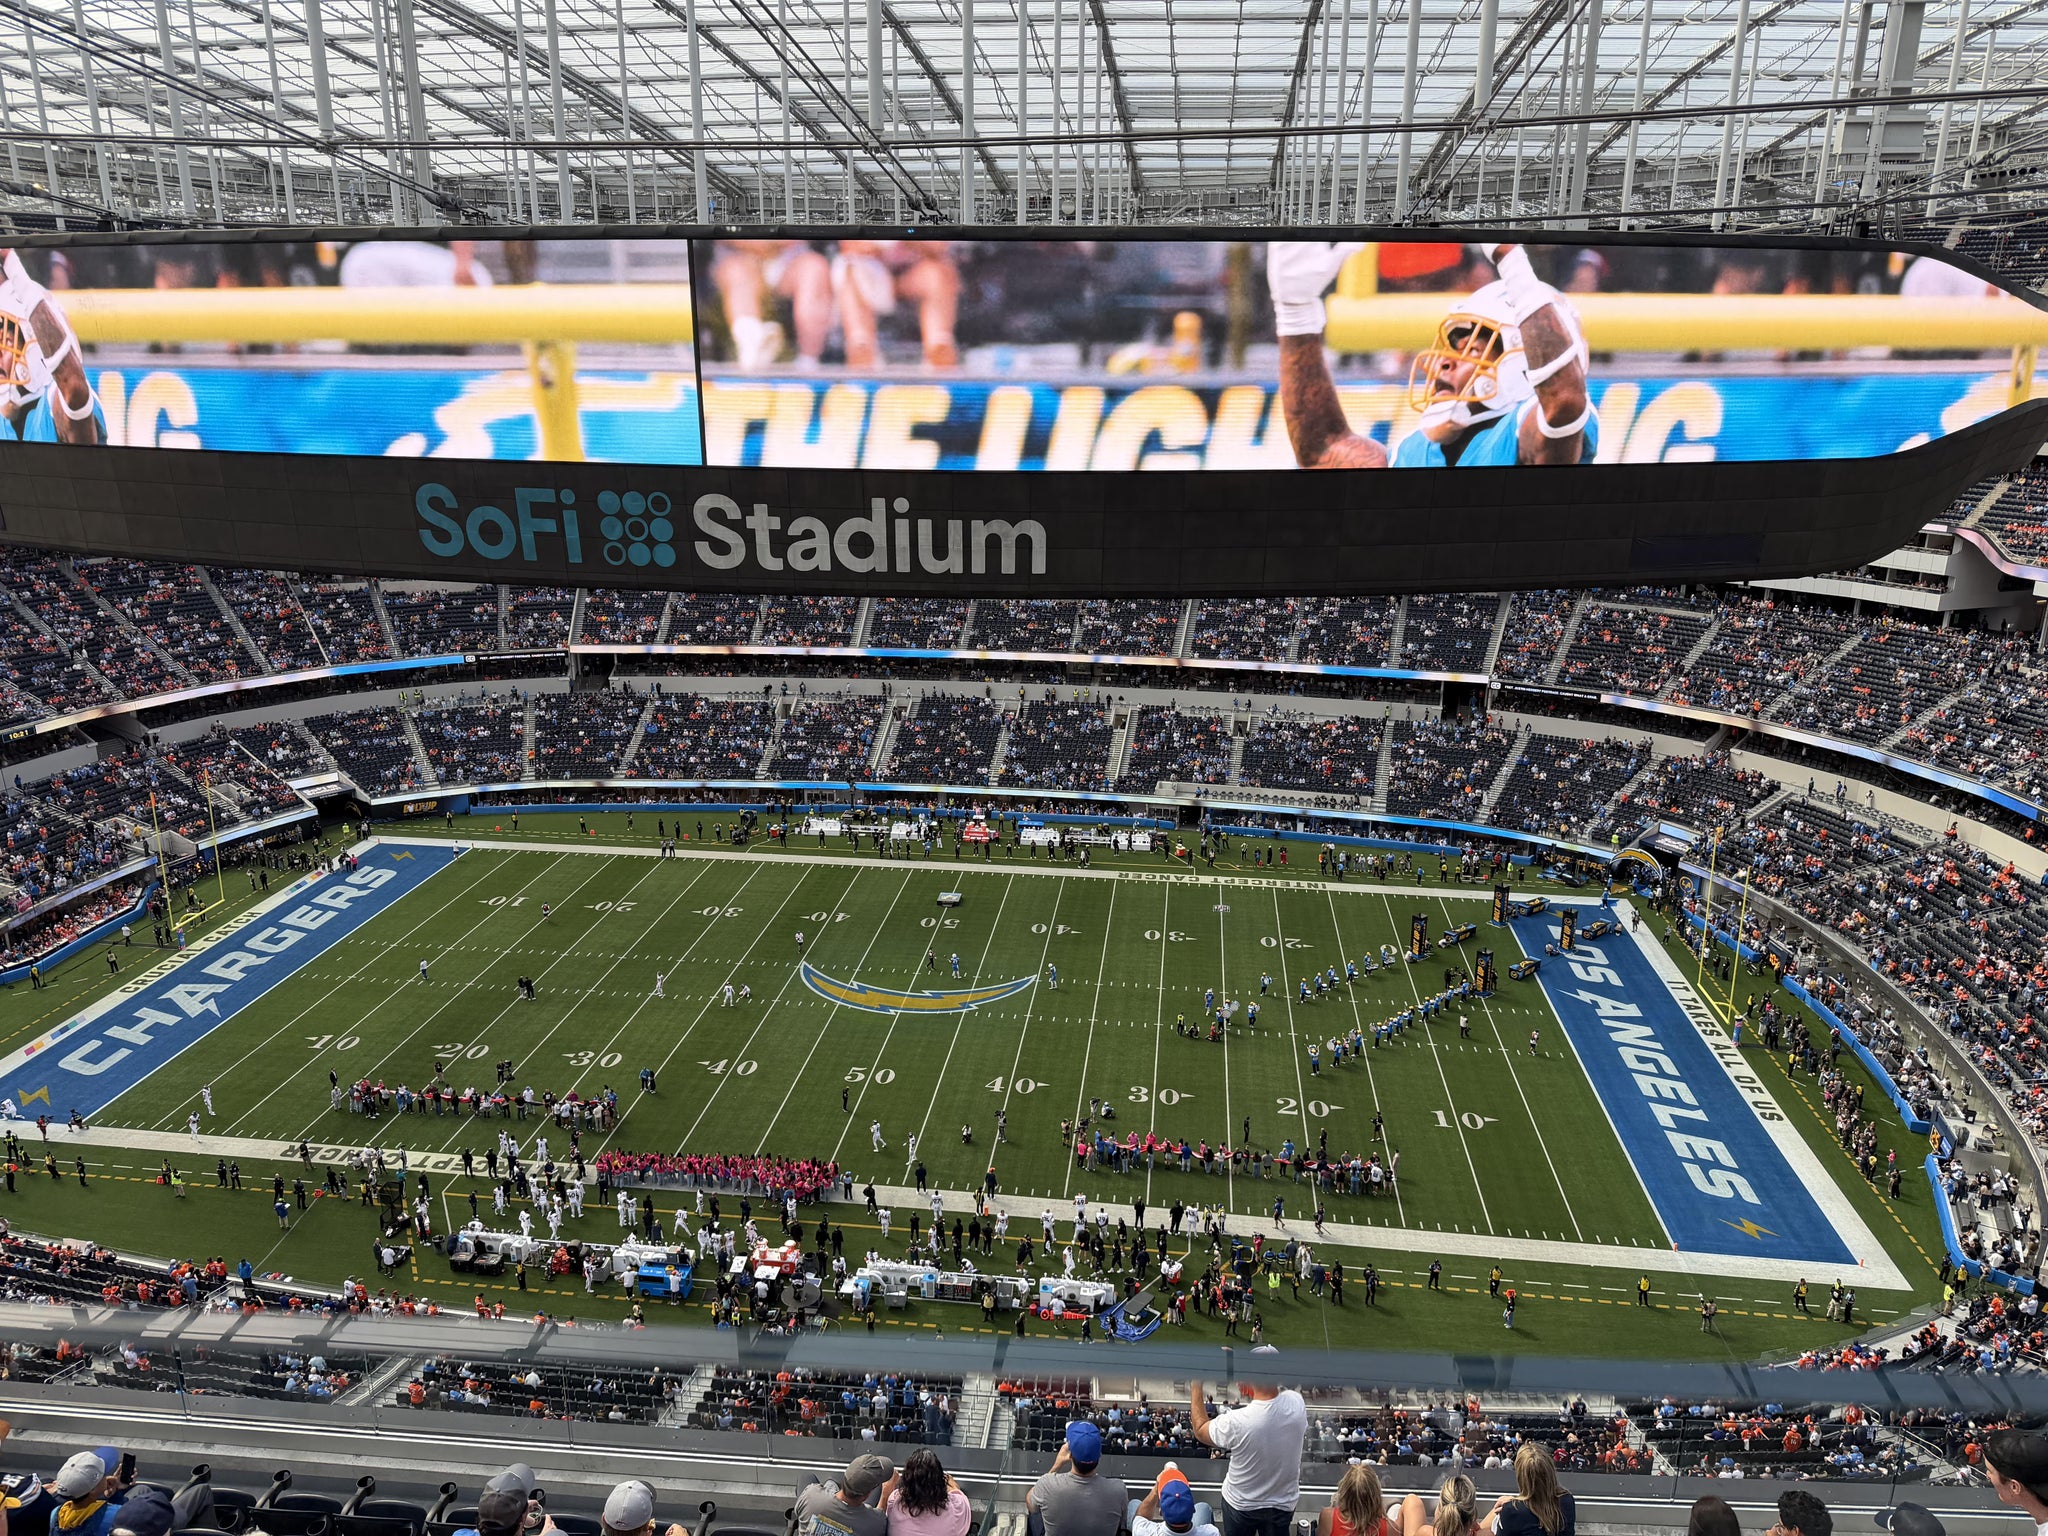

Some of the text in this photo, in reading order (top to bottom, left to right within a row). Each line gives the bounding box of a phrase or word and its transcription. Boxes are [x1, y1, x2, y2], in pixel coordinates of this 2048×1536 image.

[415, 483, 1047, 575] SoFi Stadium
[9, 730, 28, 740] 10:21
[1118, 871, 1327, 890] INTERCEPT CANCER
[487, 896, 530, 907] 10
[594, 901, 638, 912] 20
[702, 906, 744, 917] 30
[810, 911, 851, 922] 40
[920, 916, 961, 929] 50
[1031, 923, 1071, 935] 40
[1144, 930, 1185, 942] 30
[1260, 936, 1302, 949] 20
[120, 910, 263, 994] CRUCIAL CATCH
[58, 865, 398, 1077] CHARGERS
[308, 1034, 361, 1050] 10
[434, 1042, 490, 1059] 20
[569, 1051, 623, 1068] 30
[1666, 980, 1784, 1122] IT TAKES ALL OF US
[707, 1059, 758, 1076] 40
[844, 1066, 896, 1084] 50
[984, 1076, 1036, 1094] 40
[1127, 1086, 1180, 1105] 30
[1553, 988, 1762, 1206] ANGELES
[1276, 1097, 1330, 1117] 20
[1430, 1109, 1485, 1130] 10
[781, 1262, 790, 1273] G
